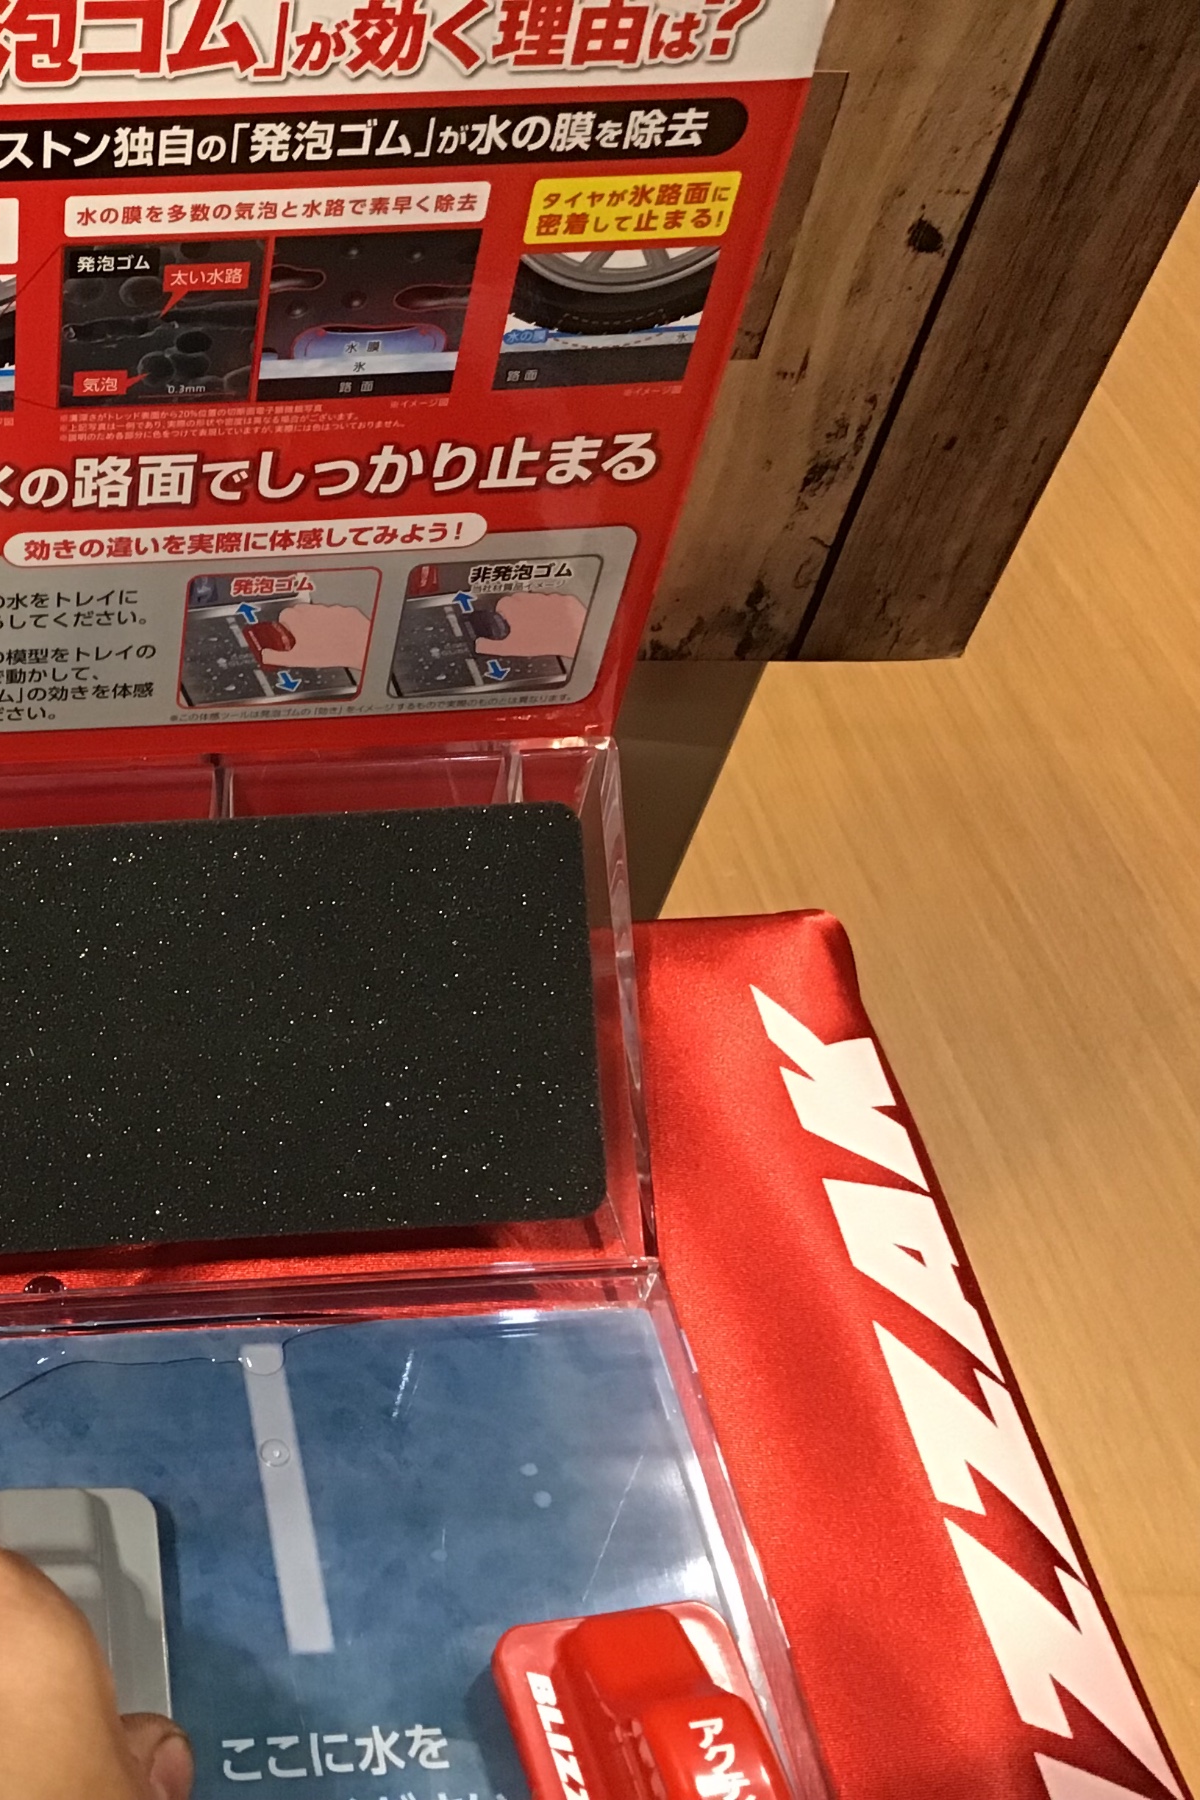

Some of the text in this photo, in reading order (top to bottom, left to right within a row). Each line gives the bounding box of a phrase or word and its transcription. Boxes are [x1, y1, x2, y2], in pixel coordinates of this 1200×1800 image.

[543, 181, 731, 211] タイヤが氷路面に
[77, 195, 477, 226] 水の膜を多数の気泡と水路で素早く除去
[536, 208, 724, 236] 密着して止まる!
[77, 254, 151, 273] 発泡ゴム
[170, 267, 243, 287] 太い水路
[353, 361, 367, 373] 氷
[82, 377, 118, 393] 気泡
[166, 384, 206, 394] 0.3mm
[23, 521, 464, 561] 効きの違いを実際に体感してみよう!
[470, 563, 573, 583] 非発泡ゴム
[232, 576, 314, 595] 発泡ゴム
[222, 1724, 450, 1781] ここに水を
